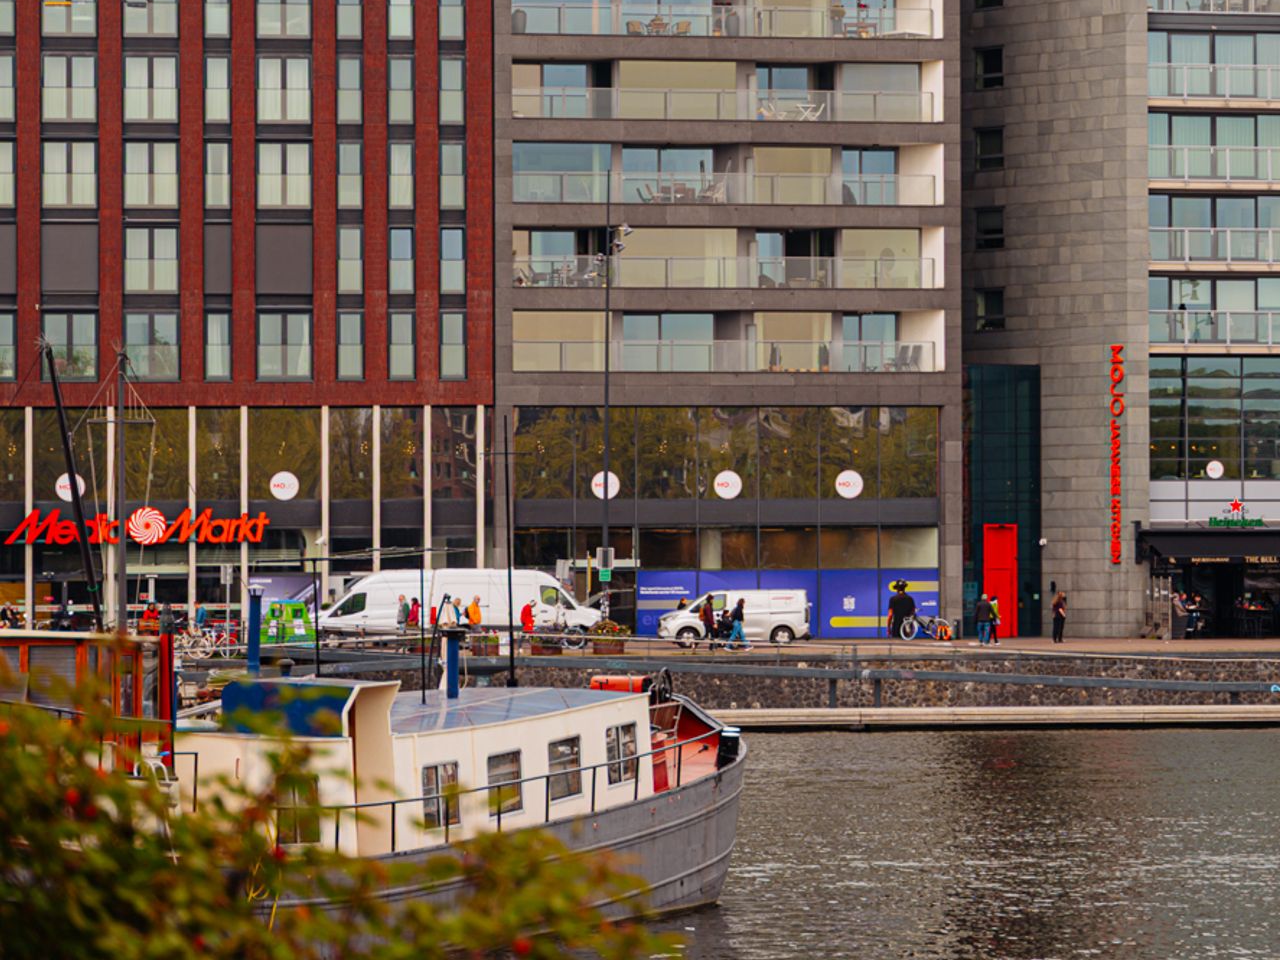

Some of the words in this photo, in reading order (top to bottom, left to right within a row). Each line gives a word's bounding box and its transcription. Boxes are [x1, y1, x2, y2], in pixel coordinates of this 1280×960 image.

[1109, 344, 1125, 417] MOJO
[1109, 419, 1121, 497] JAPANESE
[158, 507, 270, 545] Markt
[1110, 498, 1121, 564] KITCHEN
[1244, 555, 1260, 564] THE
[1260, 555, 1280, 564] BULL
